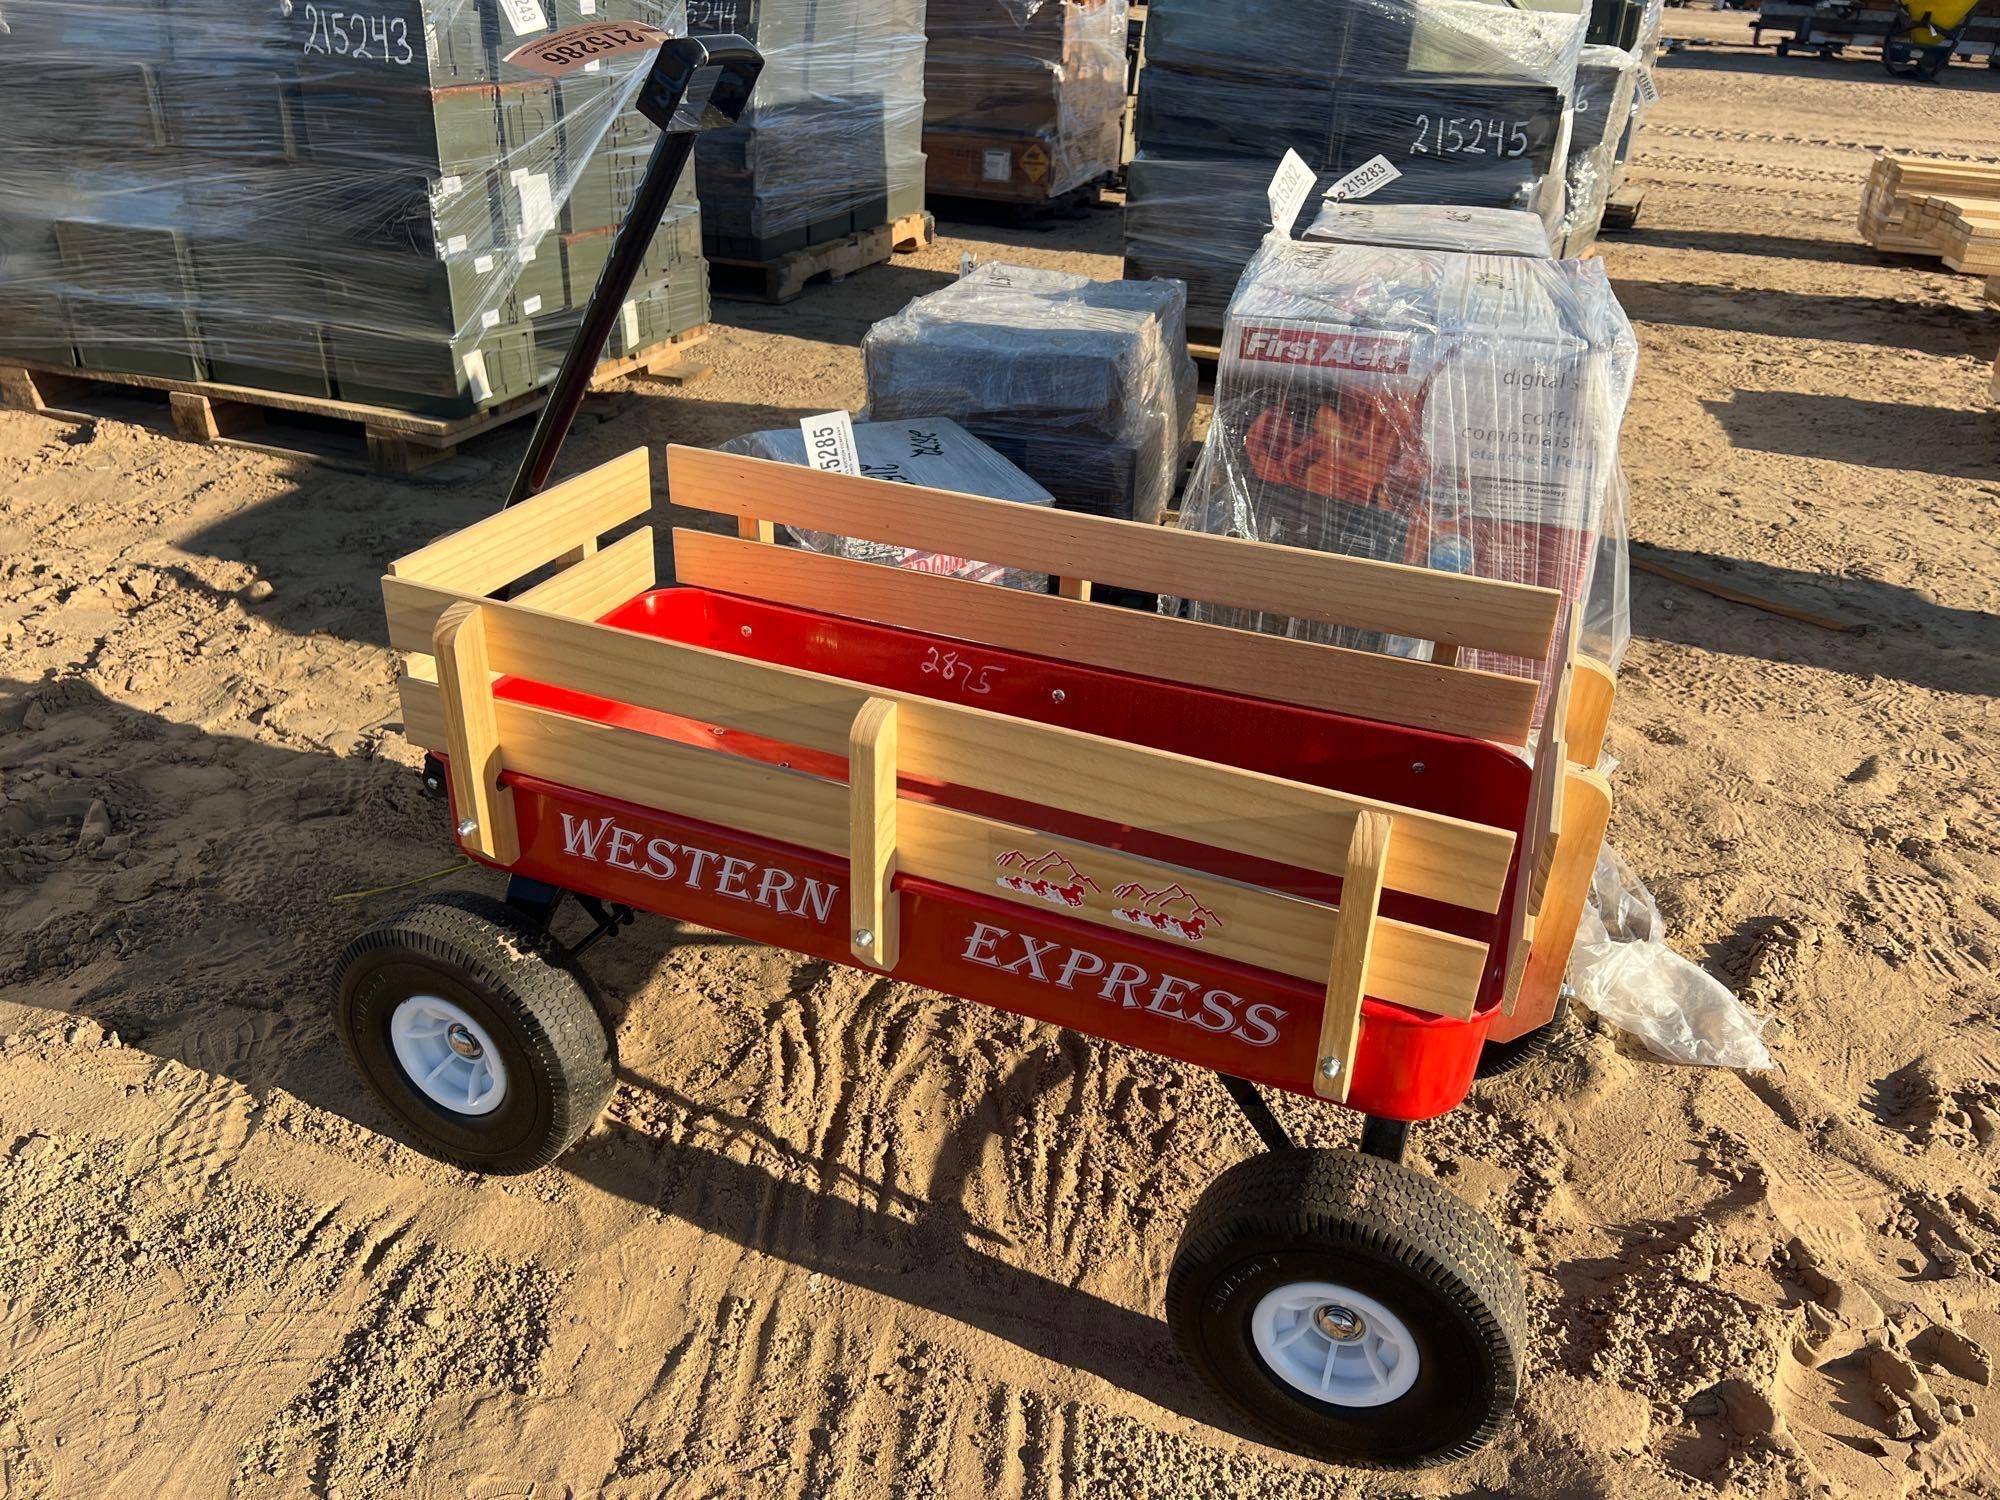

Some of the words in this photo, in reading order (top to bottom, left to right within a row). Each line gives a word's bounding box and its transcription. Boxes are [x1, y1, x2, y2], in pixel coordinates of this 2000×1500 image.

[304, 3, 413, 65] 215243
[541, 29, 645, 65] 215286
[1410, 114, 1530, 157] 215245
[1272, 163, 1301, 212] 215282
[1343, 163, 1387, 194] 215283
[1247, 332, 1319, 362] First
[1321, 339, 1402, 369] Alert
[1503, 368, 1566, 391] digital
[920, 646, 1006, 694] 2875
[560, 812, 840, 925] WESTERN
[961, 921, 1290, 1047] EXPRESS
